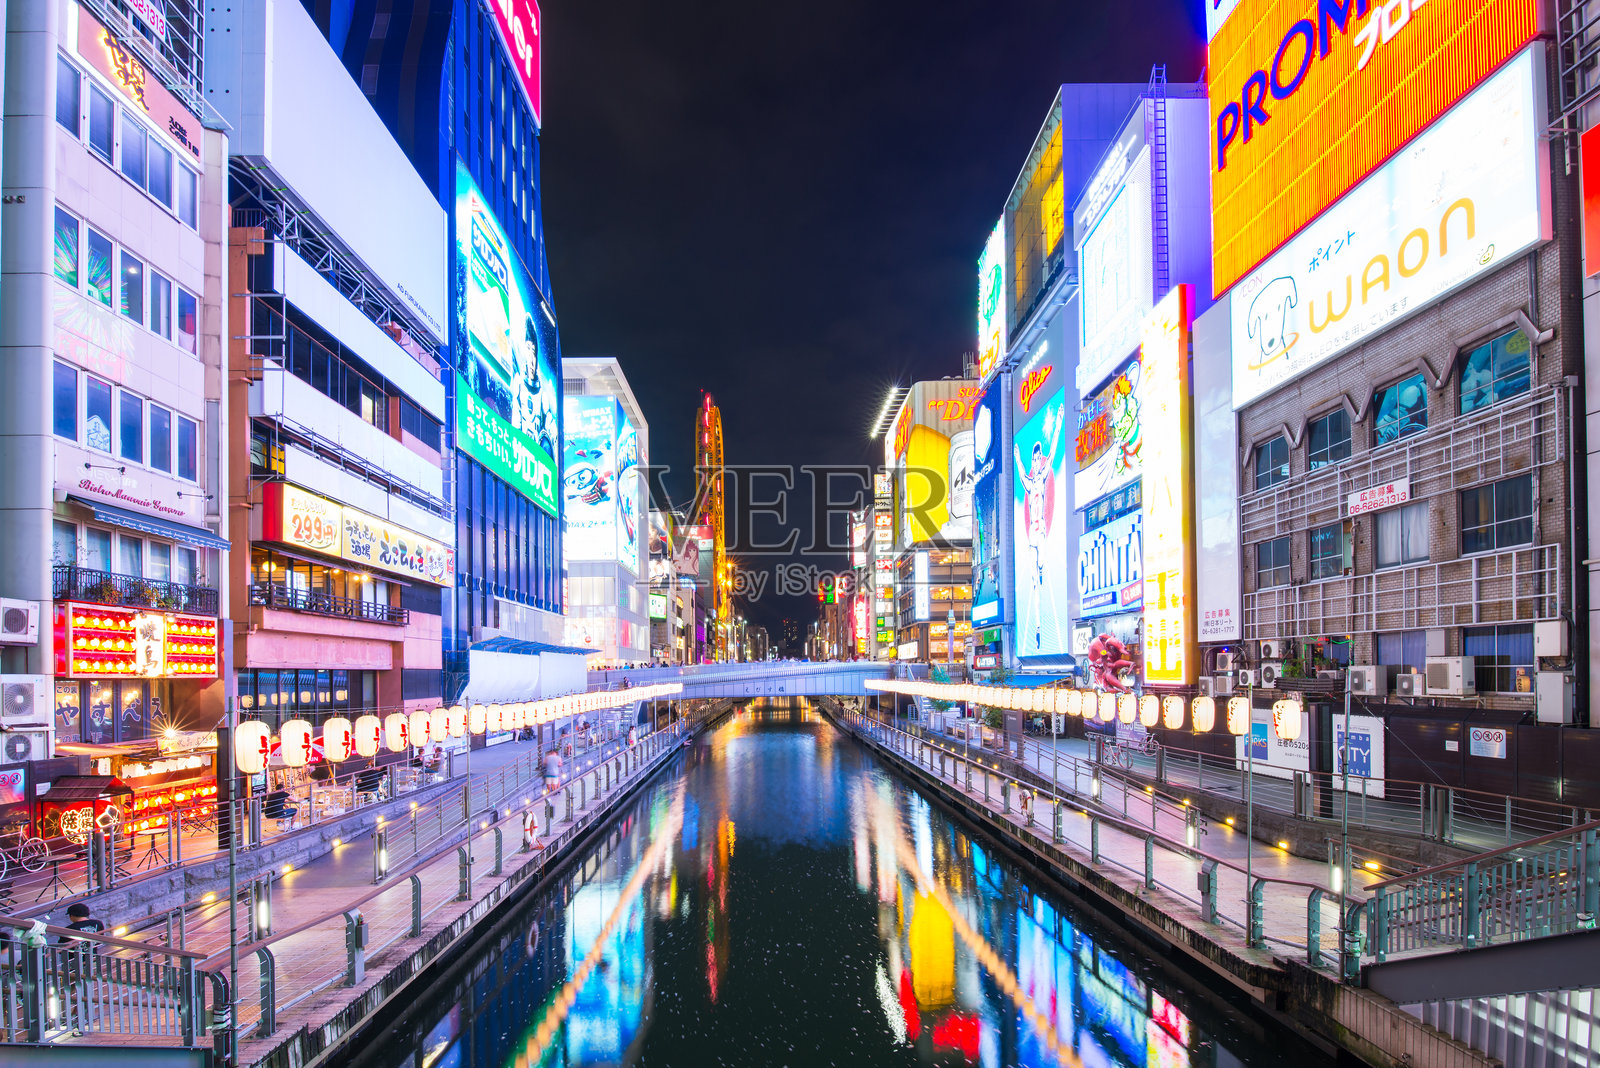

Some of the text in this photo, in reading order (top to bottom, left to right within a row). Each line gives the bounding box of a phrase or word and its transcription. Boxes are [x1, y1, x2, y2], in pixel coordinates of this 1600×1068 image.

[1217, 0, 1371, 172] PROM
[1308, 230, 1355, 273] ポイント
[1020, 366, 1053, 412] Glico
[466, 416, 512, 468] きもちいい。
[79, 479, 112, 495] Bistro
[1360, 484, 1394, 502] 広告募集
[1349, 491, 1407, 515] 06-6262-1313
[291, 514, 333, 544] 299円
[350, 538, 371, 560] 酒場
[1245, 736, 1267, 748] PRKS
[1338, 733, 1370, 741] nmba
